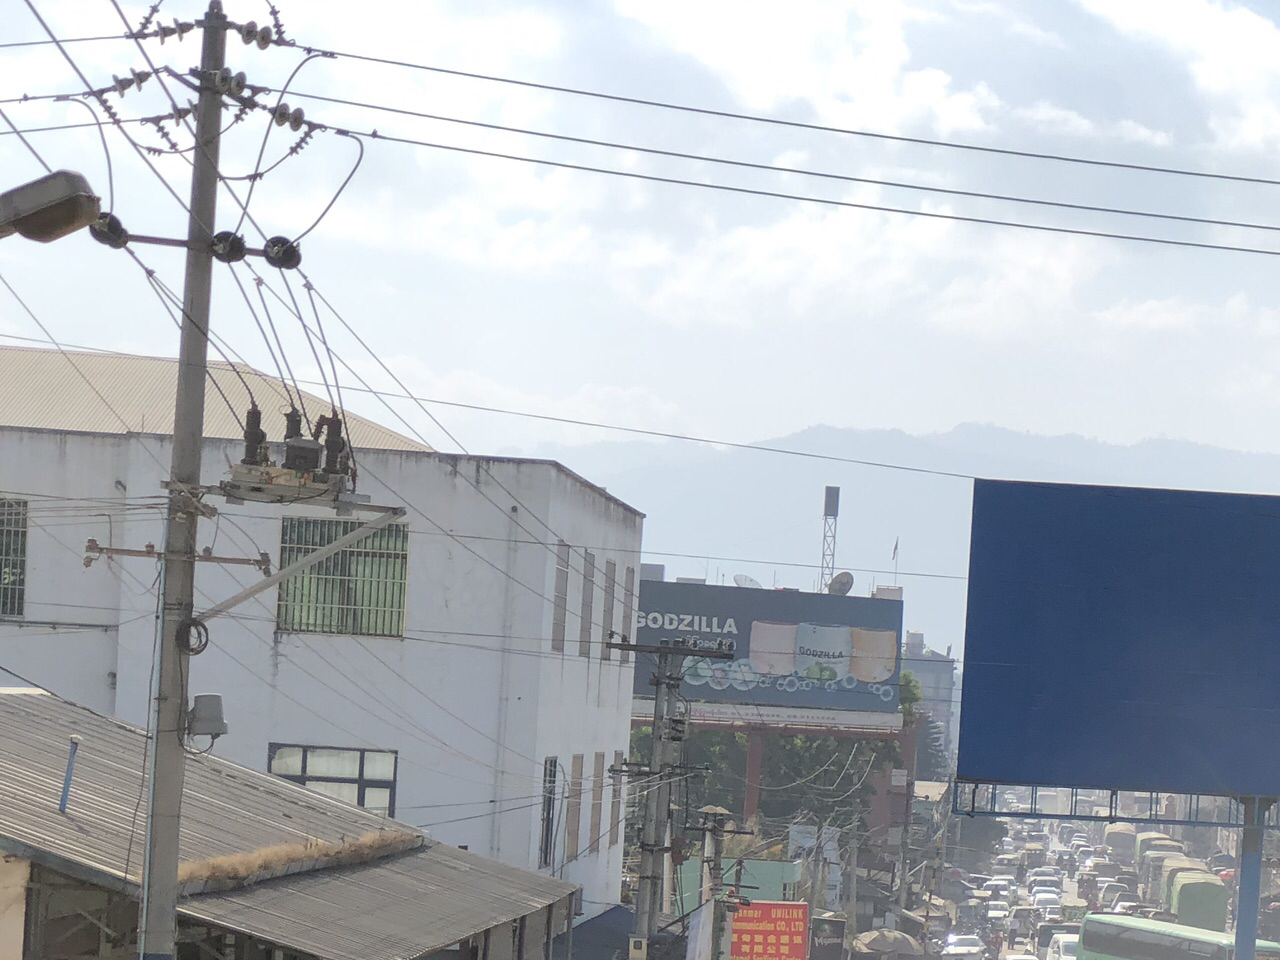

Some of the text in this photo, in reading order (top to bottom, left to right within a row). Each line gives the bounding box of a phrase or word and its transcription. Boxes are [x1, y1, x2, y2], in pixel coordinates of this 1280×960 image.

[635, 612, 738, 634] GODZILLA
[799, 646, 844, 659] GODZILLA
[771, 908, 803, 919] UNILINK
[732, 920, 774, 930] ommunication
[791, 921, 804, 931] LTD
[741, 944, 789, 954] 有限公司
